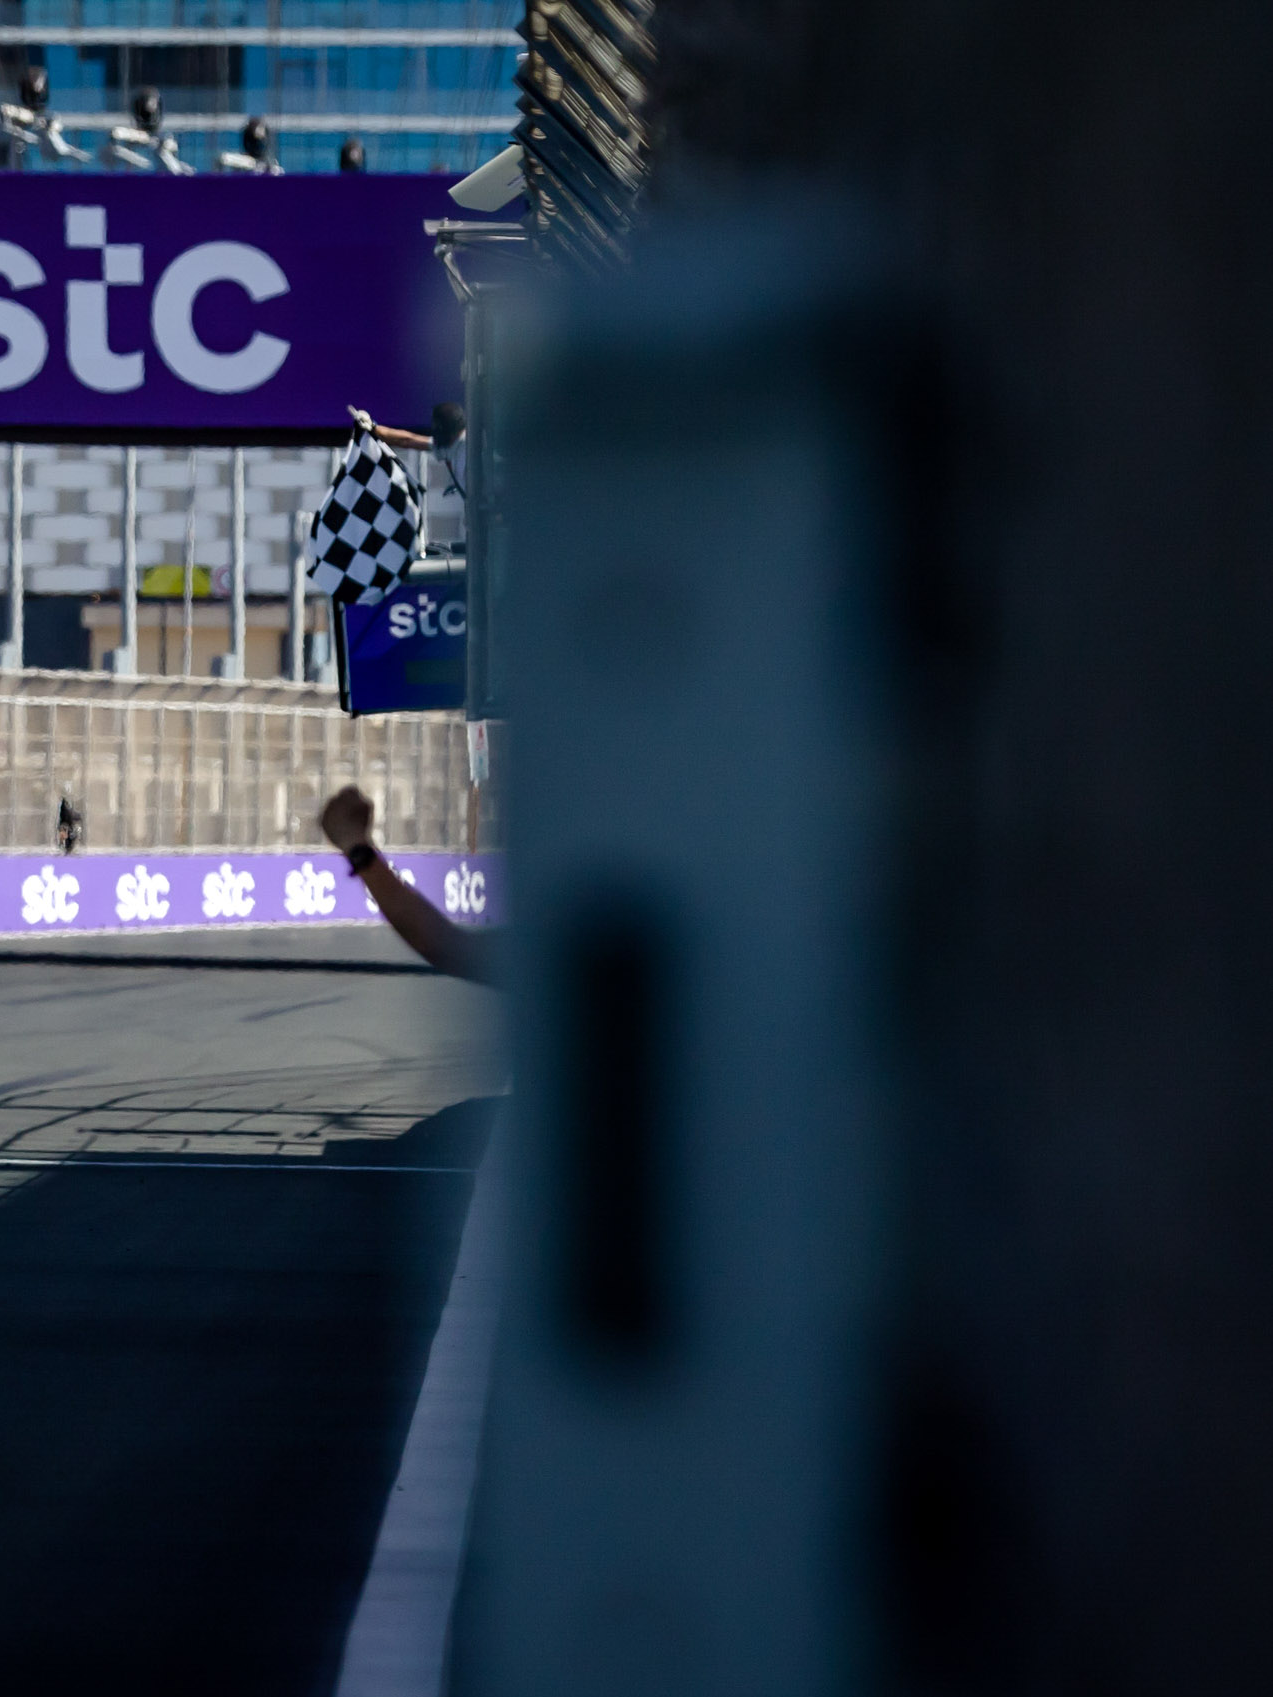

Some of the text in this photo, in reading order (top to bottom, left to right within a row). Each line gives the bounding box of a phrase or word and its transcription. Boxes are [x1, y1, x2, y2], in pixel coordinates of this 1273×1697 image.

[388, 593, 467, 639] stc
[21, 864, 81, 924] stc
[115, 864, 171, 921] stc
[202, 862, 256, 918] stc
[284, 861, 337, 916] stc
[444, 860, 487, 914] stc
